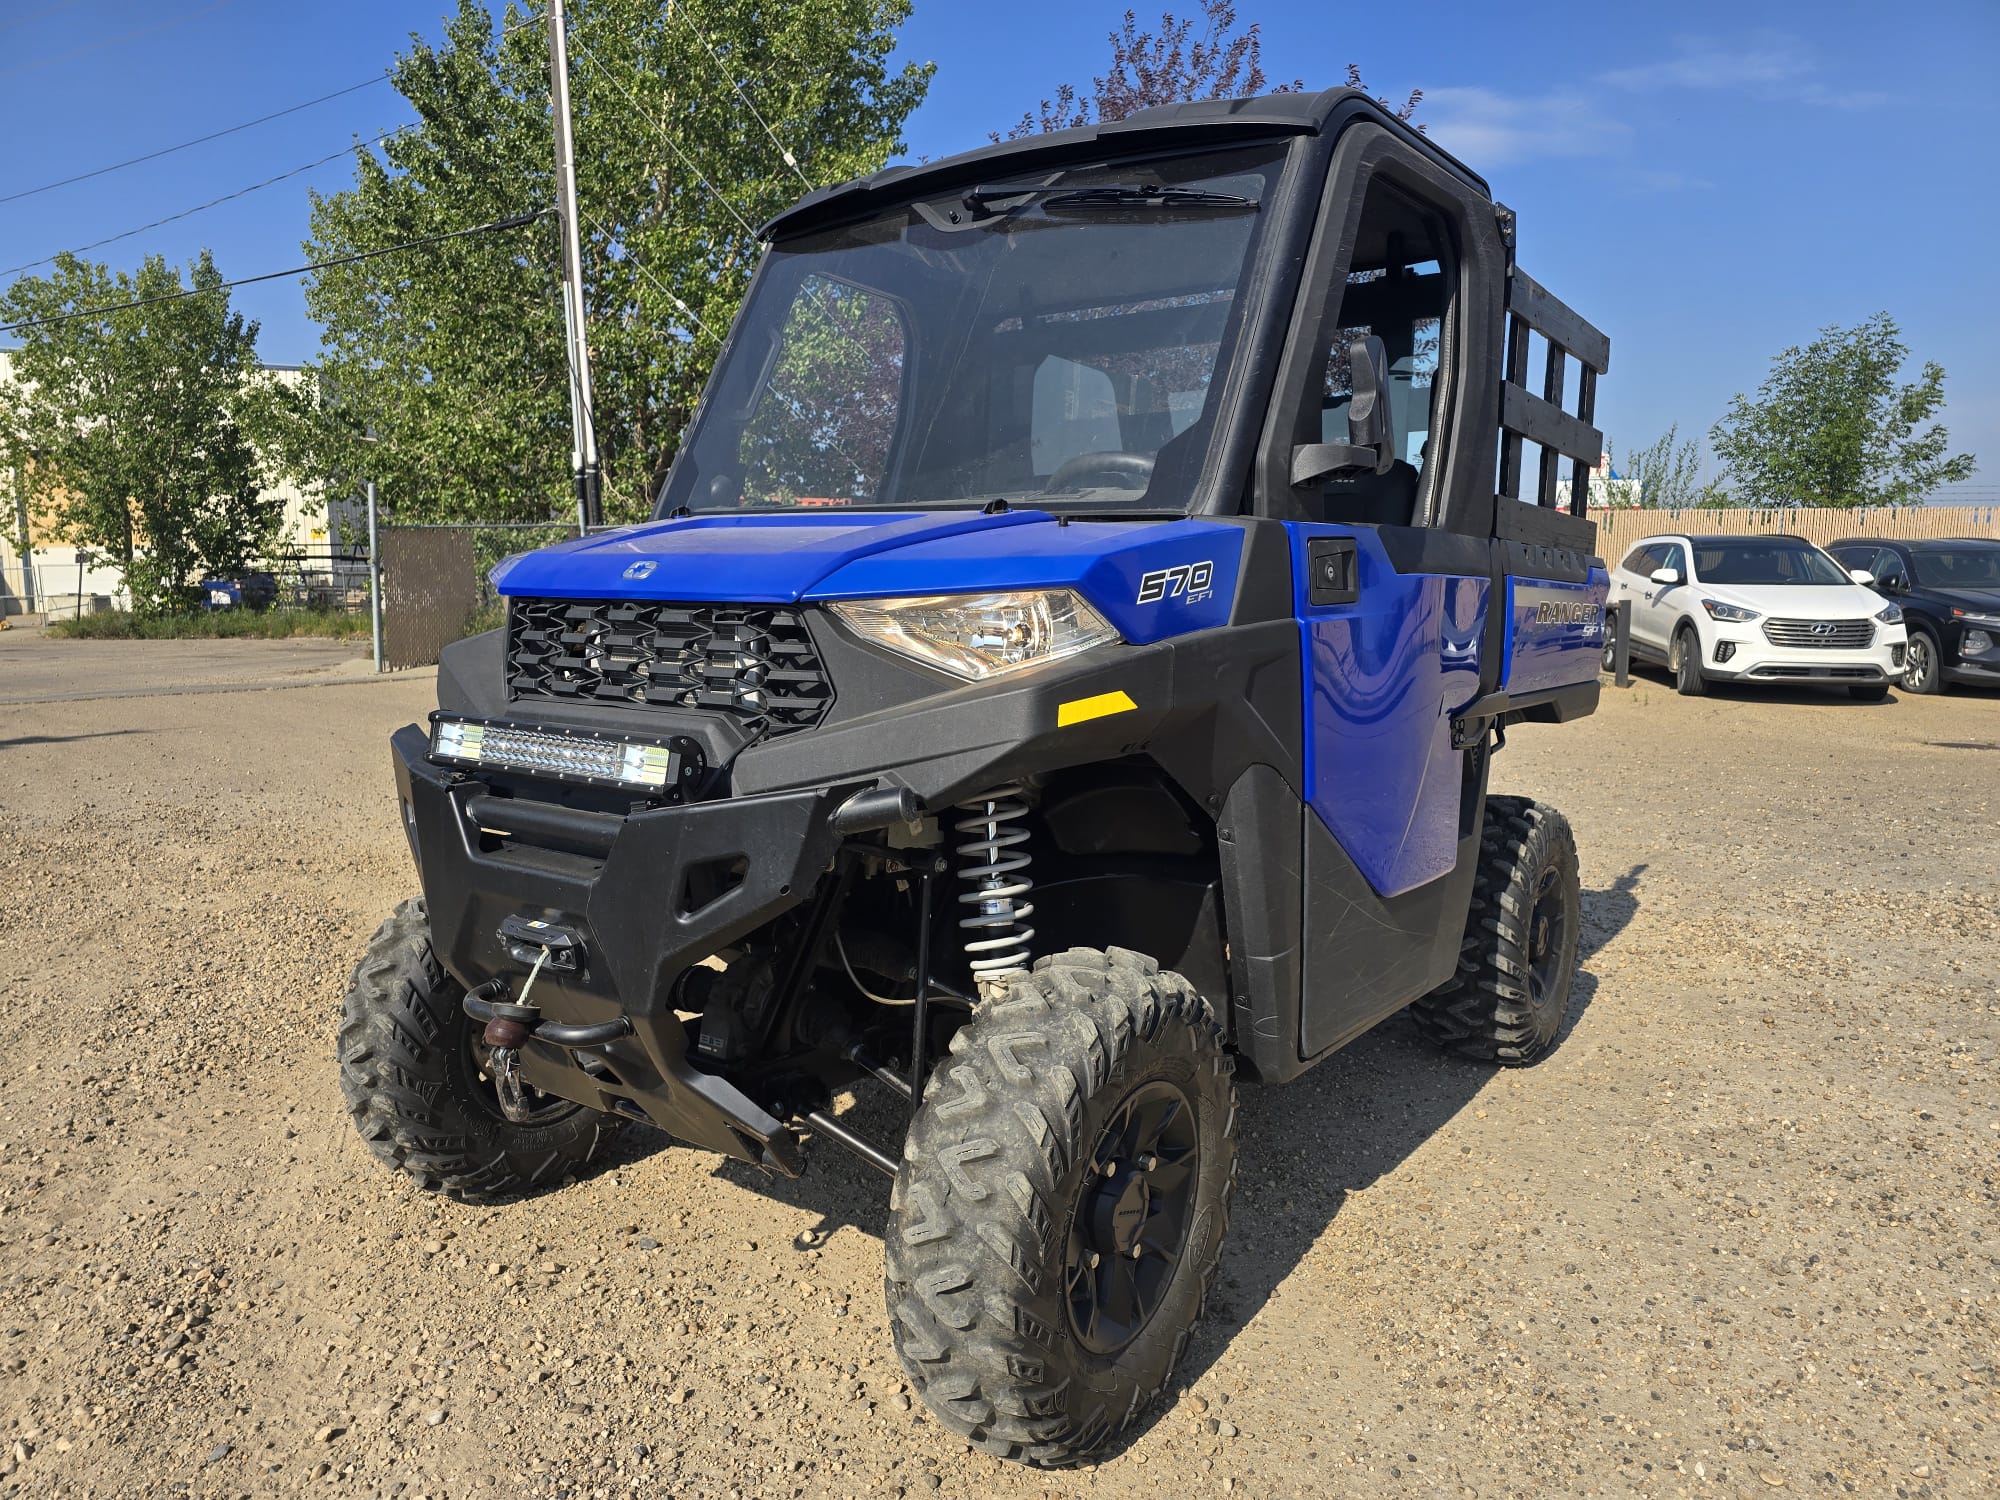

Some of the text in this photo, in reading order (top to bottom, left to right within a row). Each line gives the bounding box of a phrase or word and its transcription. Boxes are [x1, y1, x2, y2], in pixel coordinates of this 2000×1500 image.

[1136, 560, 1213, 605] 570
[1186, 590, 1213, 605] EFI
[1536, 600, 1600, 625] RANGER
[1582, 625, 1599, 637] SP
